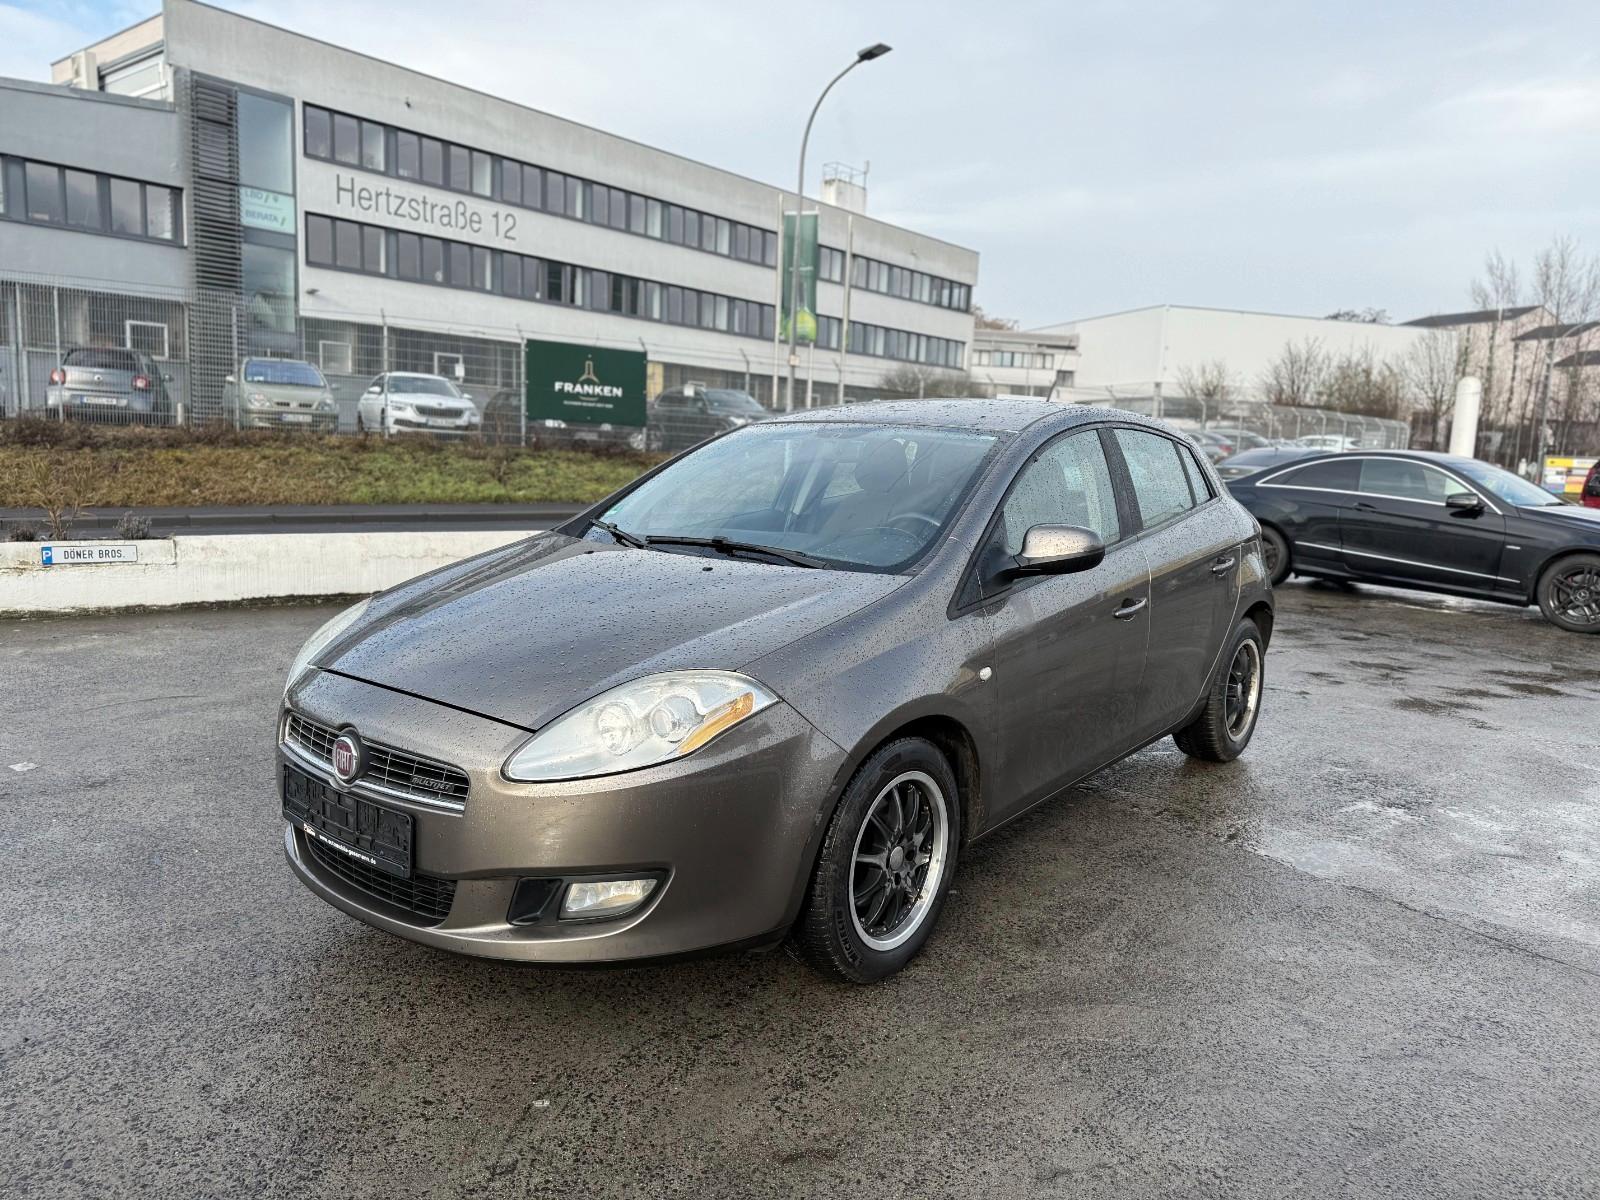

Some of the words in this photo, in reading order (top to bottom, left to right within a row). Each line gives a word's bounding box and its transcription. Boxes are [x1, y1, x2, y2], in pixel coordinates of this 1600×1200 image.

[336, 174, 483, 233] Hertzstraße
[492, 211, 517, 241] 12
[554, 381, 623, 398] FRANKEN
[63, 548, 94, 560] DÖNER
[98, 549, 126, 559] BROS.
[337, 748, 352, 771] FIAT
